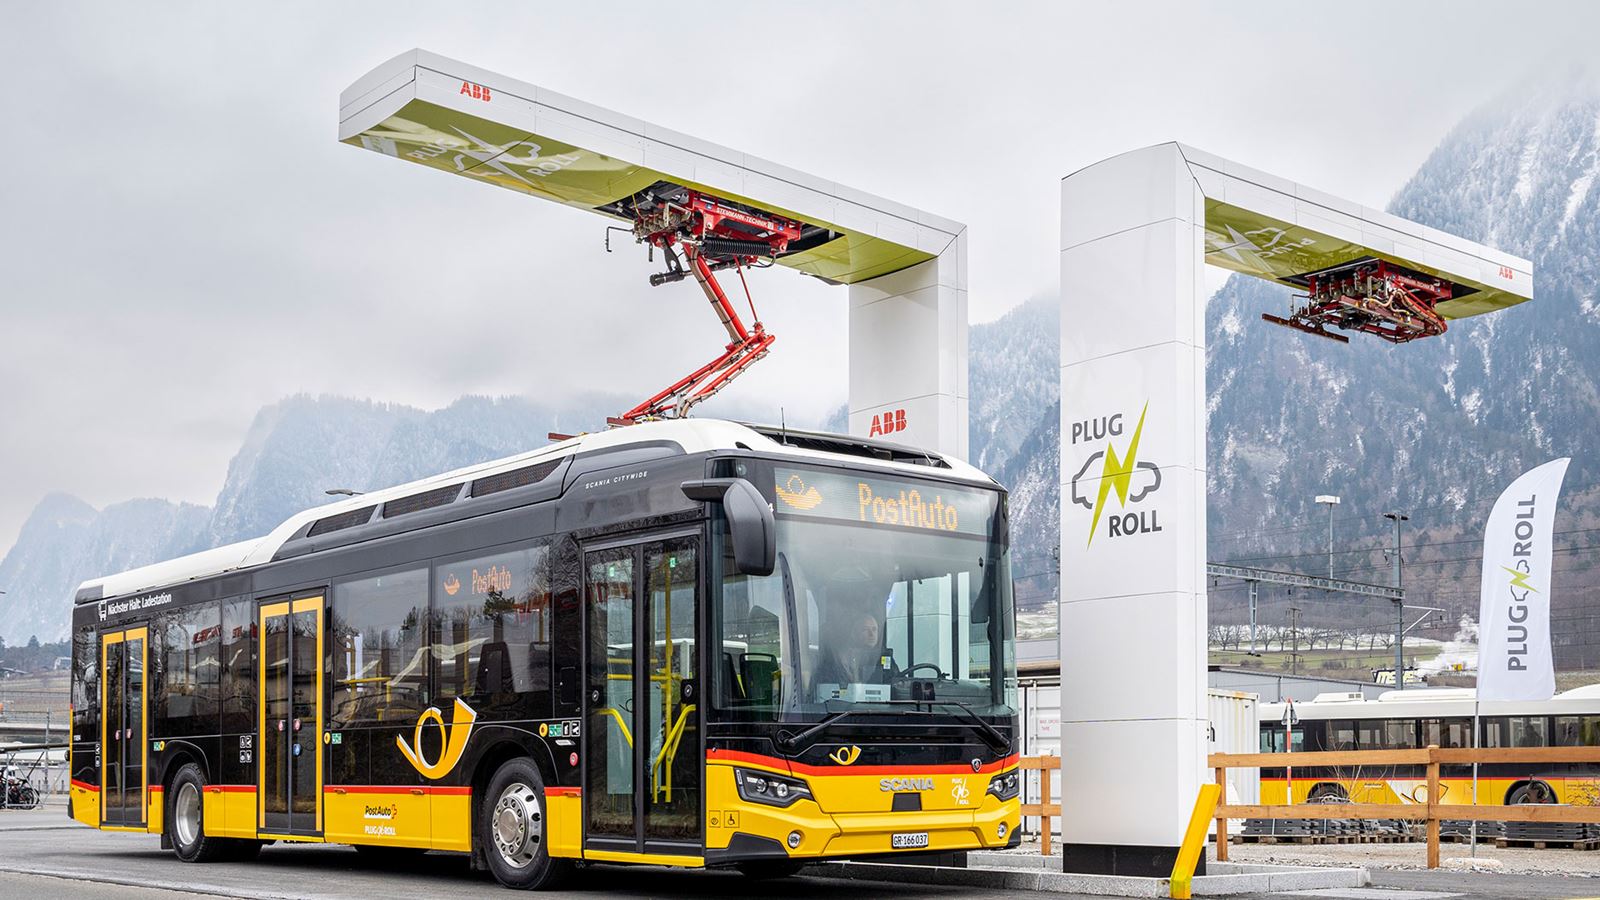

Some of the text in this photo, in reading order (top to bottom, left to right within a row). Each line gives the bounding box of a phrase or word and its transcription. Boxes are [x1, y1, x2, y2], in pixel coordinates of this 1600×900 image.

[460, 81, 491, 102] ABB
[527, 153, 581, 177] ROLL
[1499, 266, 1513, 280] ABB
[869, 409, 907, 438] ABB
[1072, 413, 1123, 444] PLUG
[585, 470, 648, 490] SCANIA CITYWIDE
[858, 482, 959, 531] PostAuto
[1109, 510, 1162, 538] ROLL
[471, 564, 512, 595] PostAuto
[1507, 494, 1536, 671] PLUG ROLL
[108, 602, 128, 616] Nächster
[142, 592, 172, 608] Ladestation
[880, 778, 935, 791] SCANIA
[365, 805, 392, 816] PostAuto
